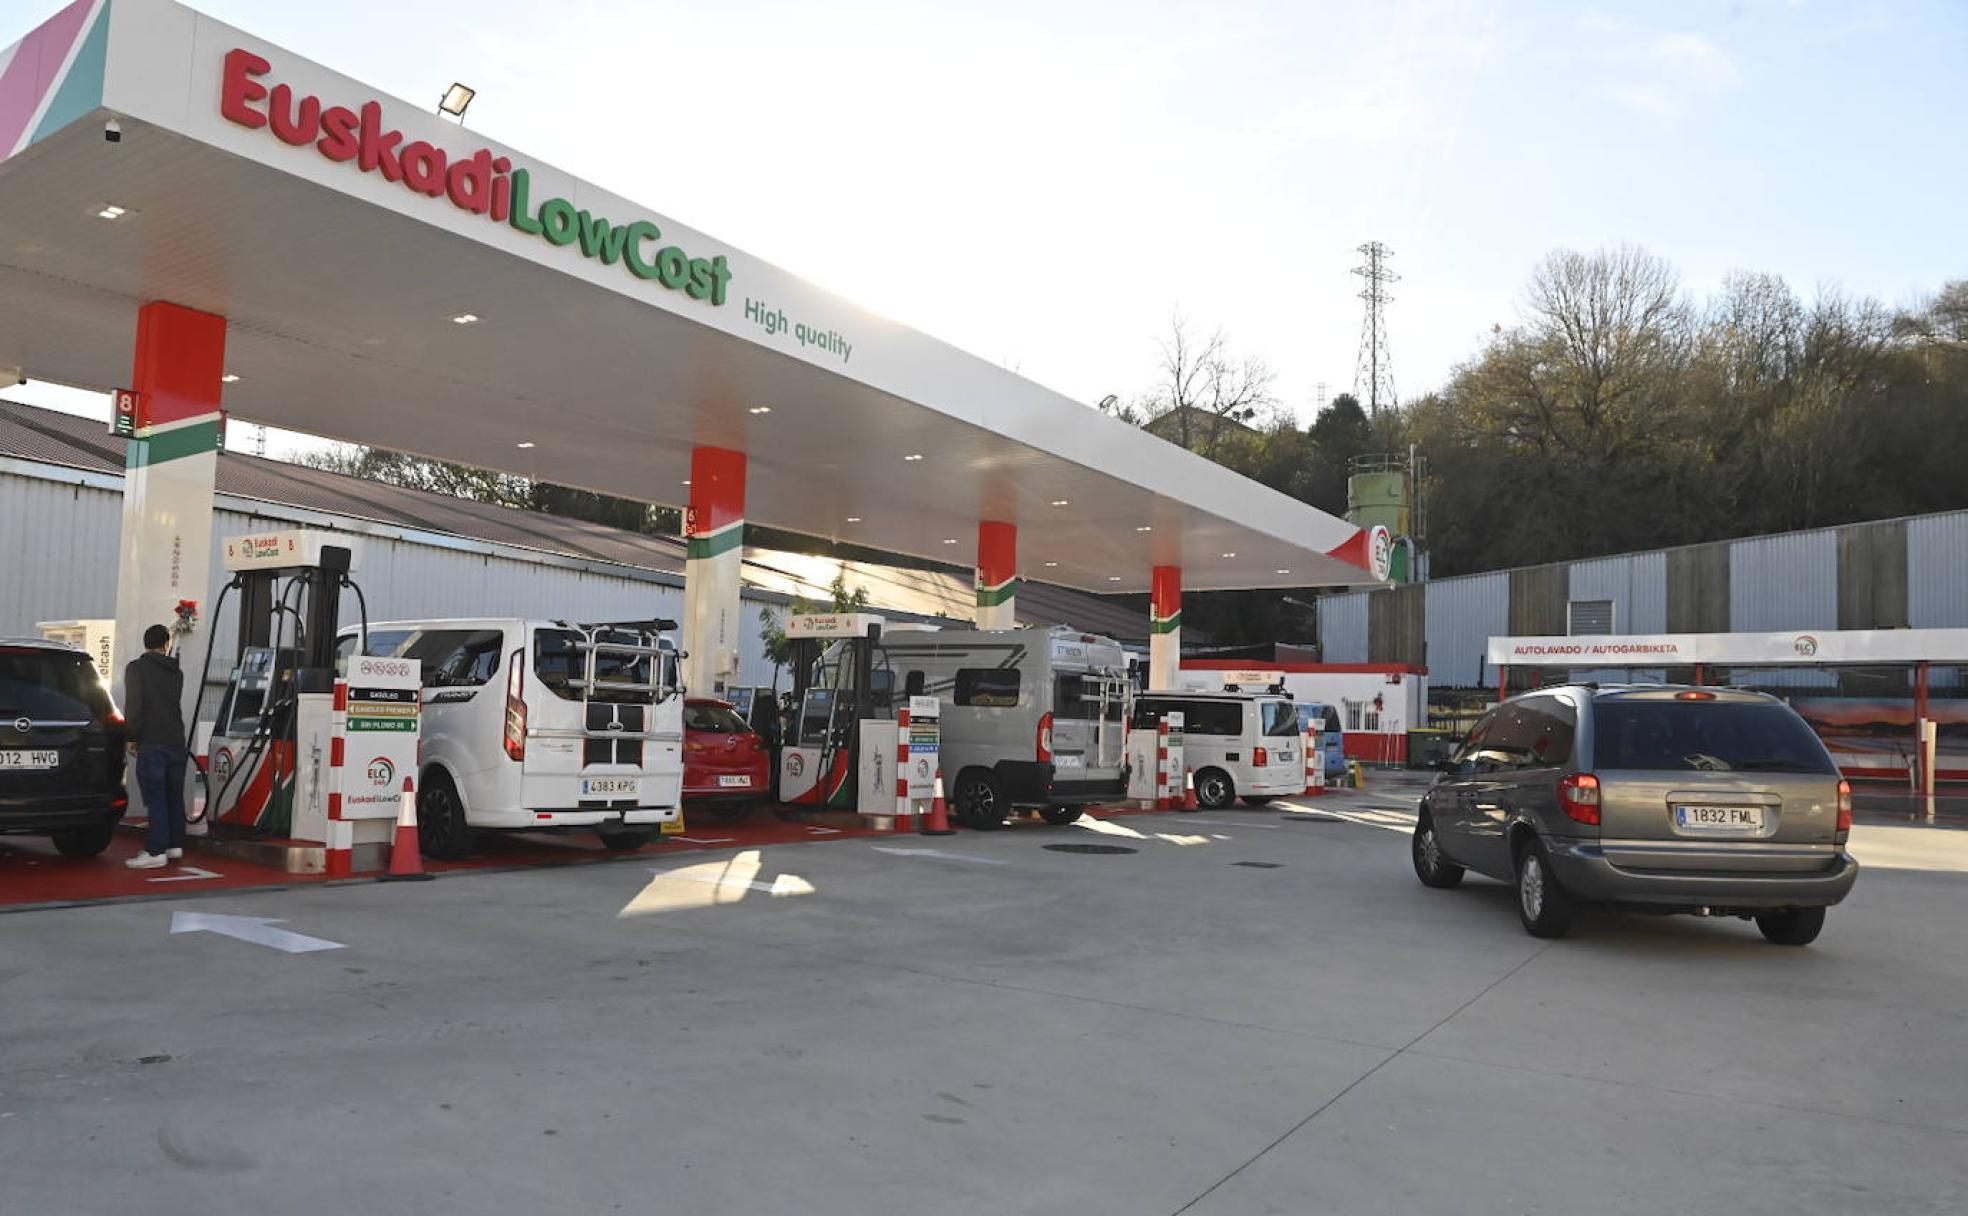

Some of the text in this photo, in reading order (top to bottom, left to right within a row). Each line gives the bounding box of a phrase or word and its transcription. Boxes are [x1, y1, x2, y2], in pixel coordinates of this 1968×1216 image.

[221, 48, 732, 305] EuskadiLowCost
[745, 297, 852, 363] High quality
[120, 394, 133, 412] 8
[688, 509, 696, 522] 6
[1514, 646, 1582, 654] AUTOLAVADO
[1592, 644, 1679, 654] AUTOGARBIKETA
[367, 768, 387, 779] ELC
[590, 780, 614, 792] 4383
[1692, 808, 1757, 824] 1832 FML
